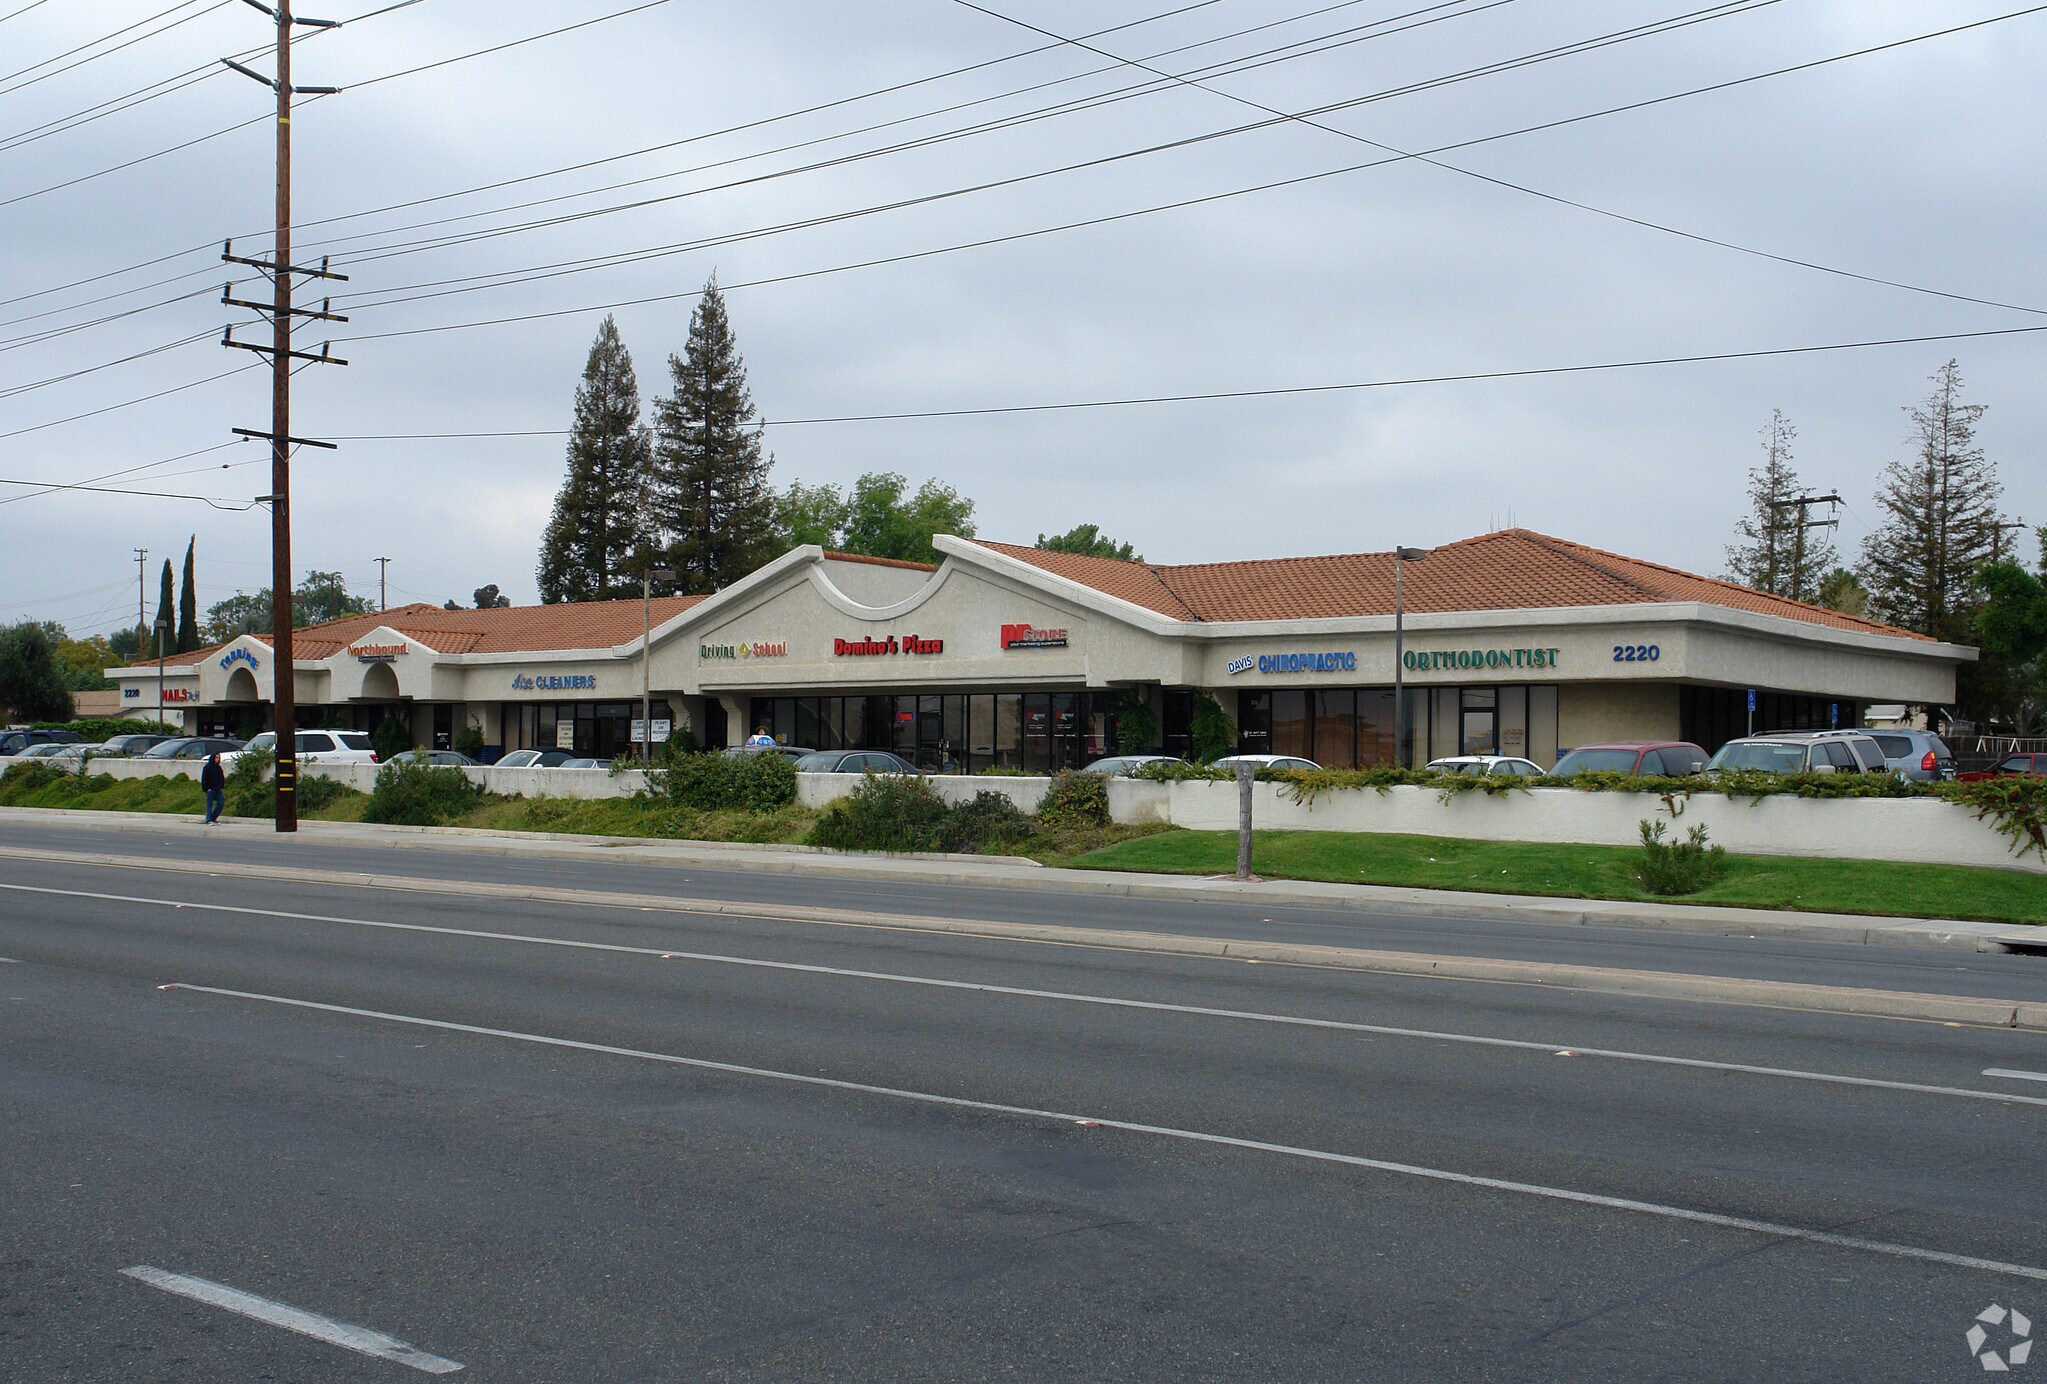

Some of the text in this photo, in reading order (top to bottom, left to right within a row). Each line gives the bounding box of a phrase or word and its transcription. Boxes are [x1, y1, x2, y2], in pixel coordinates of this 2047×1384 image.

[1023, 628, 1068, 641] STORE
[347, 642, 408, 657] Northbound
[701, 641, 788, 659] Driving School
[834, 633, 944, 656] Domino's Pizza
[219, 647, 258, 670] Tanning
[1403, 648, 1560, 671] ORTHODONTIST
[1613, 645, 1661, 662] 2220
[1227, 651, 1358, 674] DAVIS CHIROPRACTIC
[511, 673, 597, 690] Ace CLEANERS
[162, 688, 188, 701] NAILS
